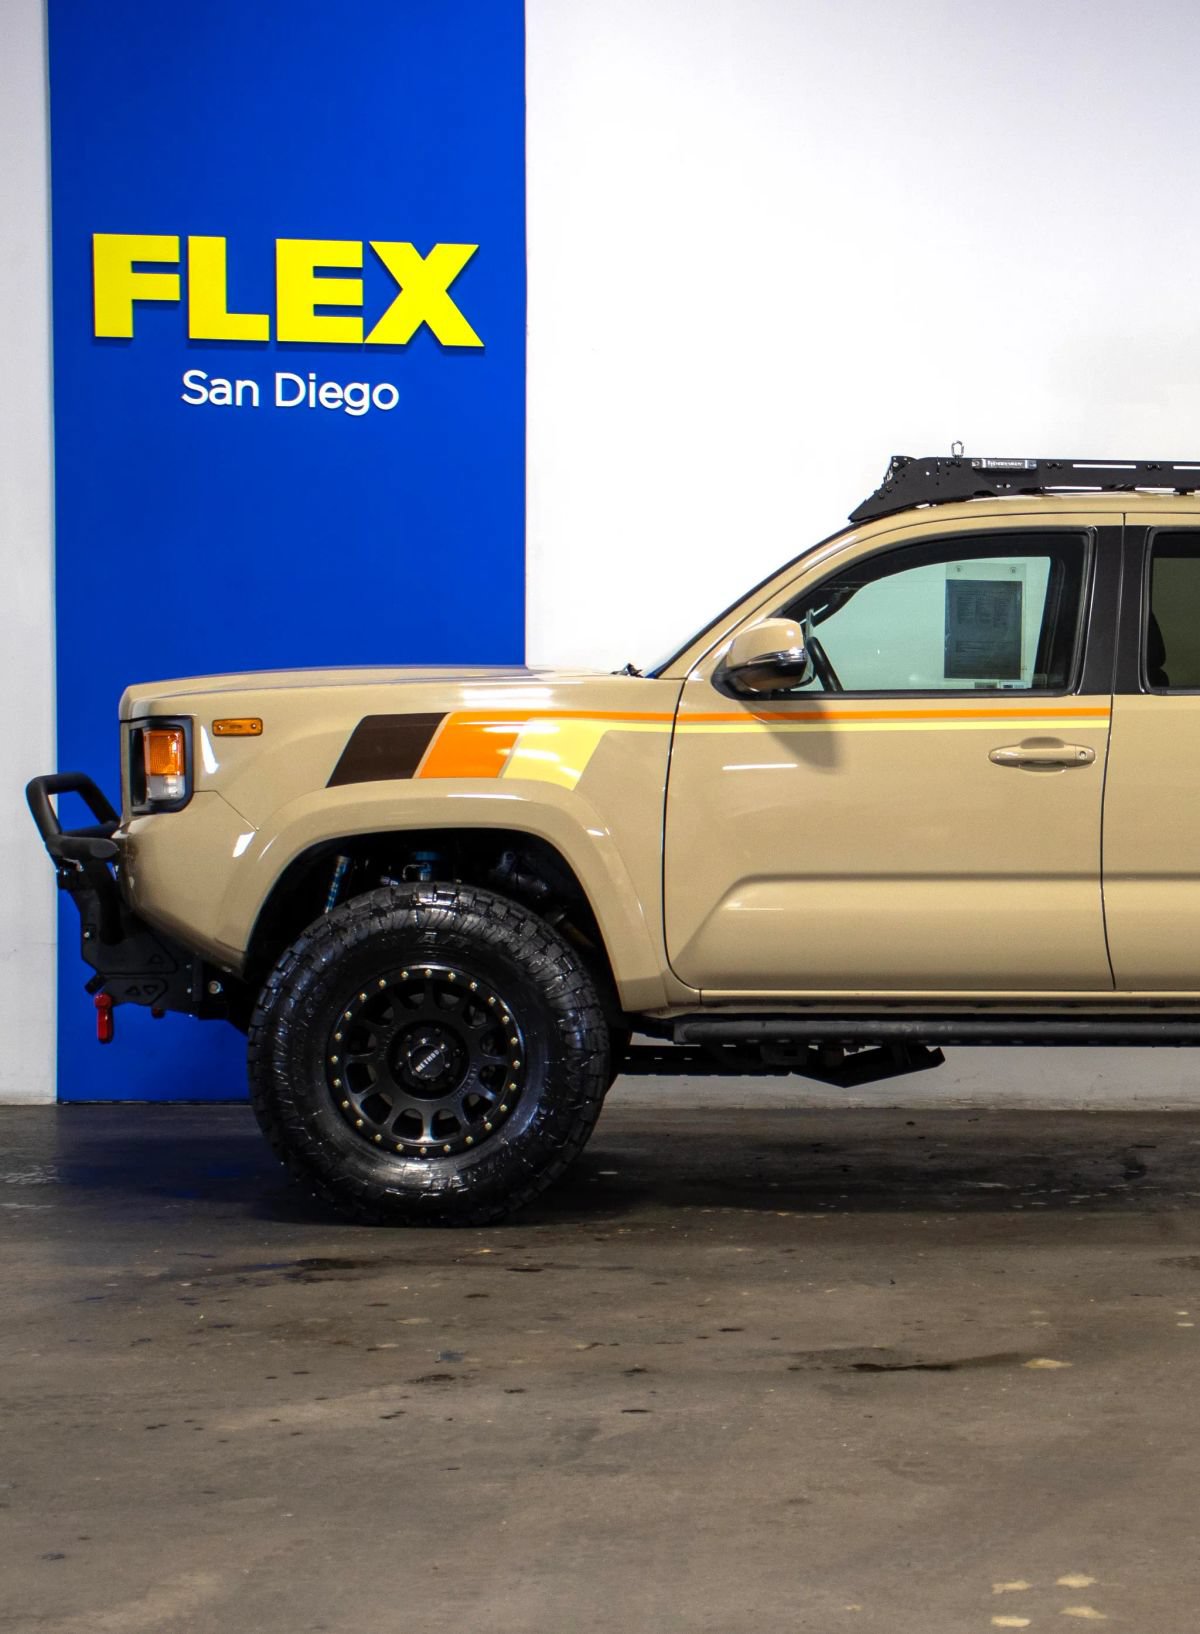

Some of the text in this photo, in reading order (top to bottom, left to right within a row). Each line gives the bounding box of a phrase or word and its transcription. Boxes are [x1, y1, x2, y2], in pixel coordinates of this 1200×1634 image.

[93, 233, 485, 347] FLEX
[181, 369, 399, 416] San Diego
